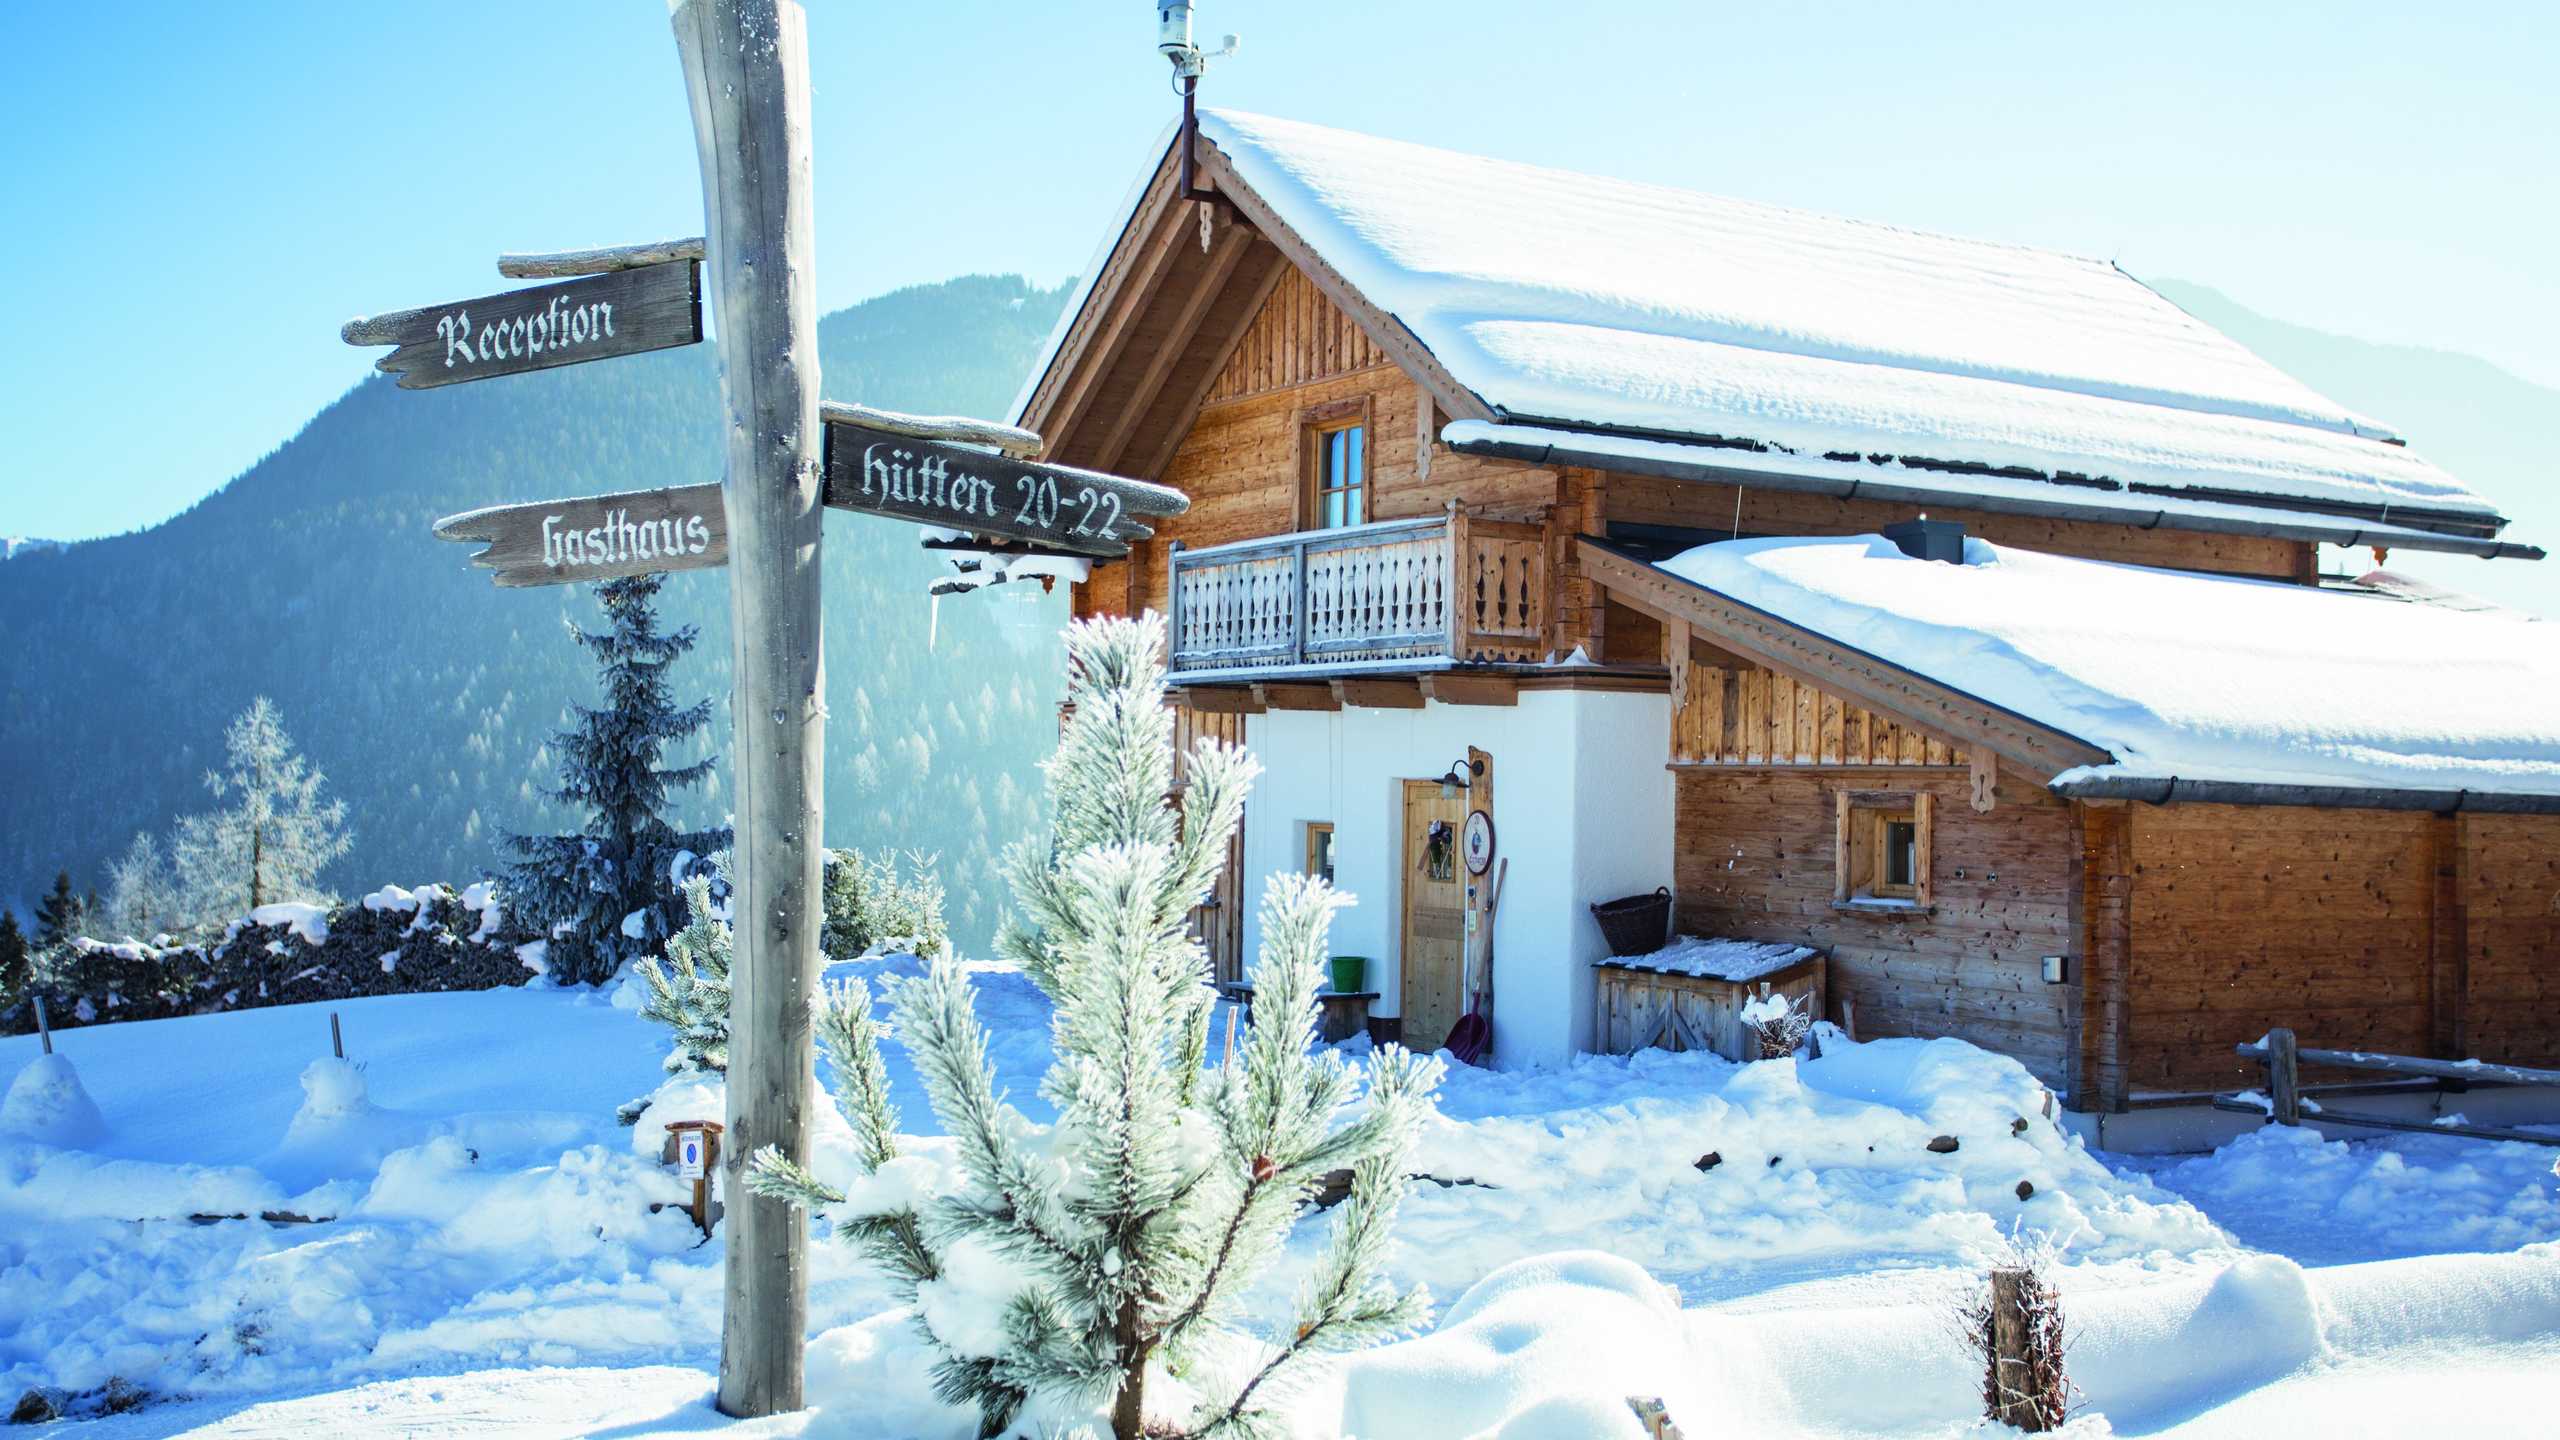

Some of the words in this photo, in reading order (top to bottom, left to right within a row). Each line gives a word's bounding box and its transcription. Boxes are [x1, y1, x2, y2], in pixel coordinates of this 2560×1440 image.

[437, 295, 616, 367] Reception
[542, 508, 710, 568] Gasthaus
[1015, 474, 1121, 540] 20-22
